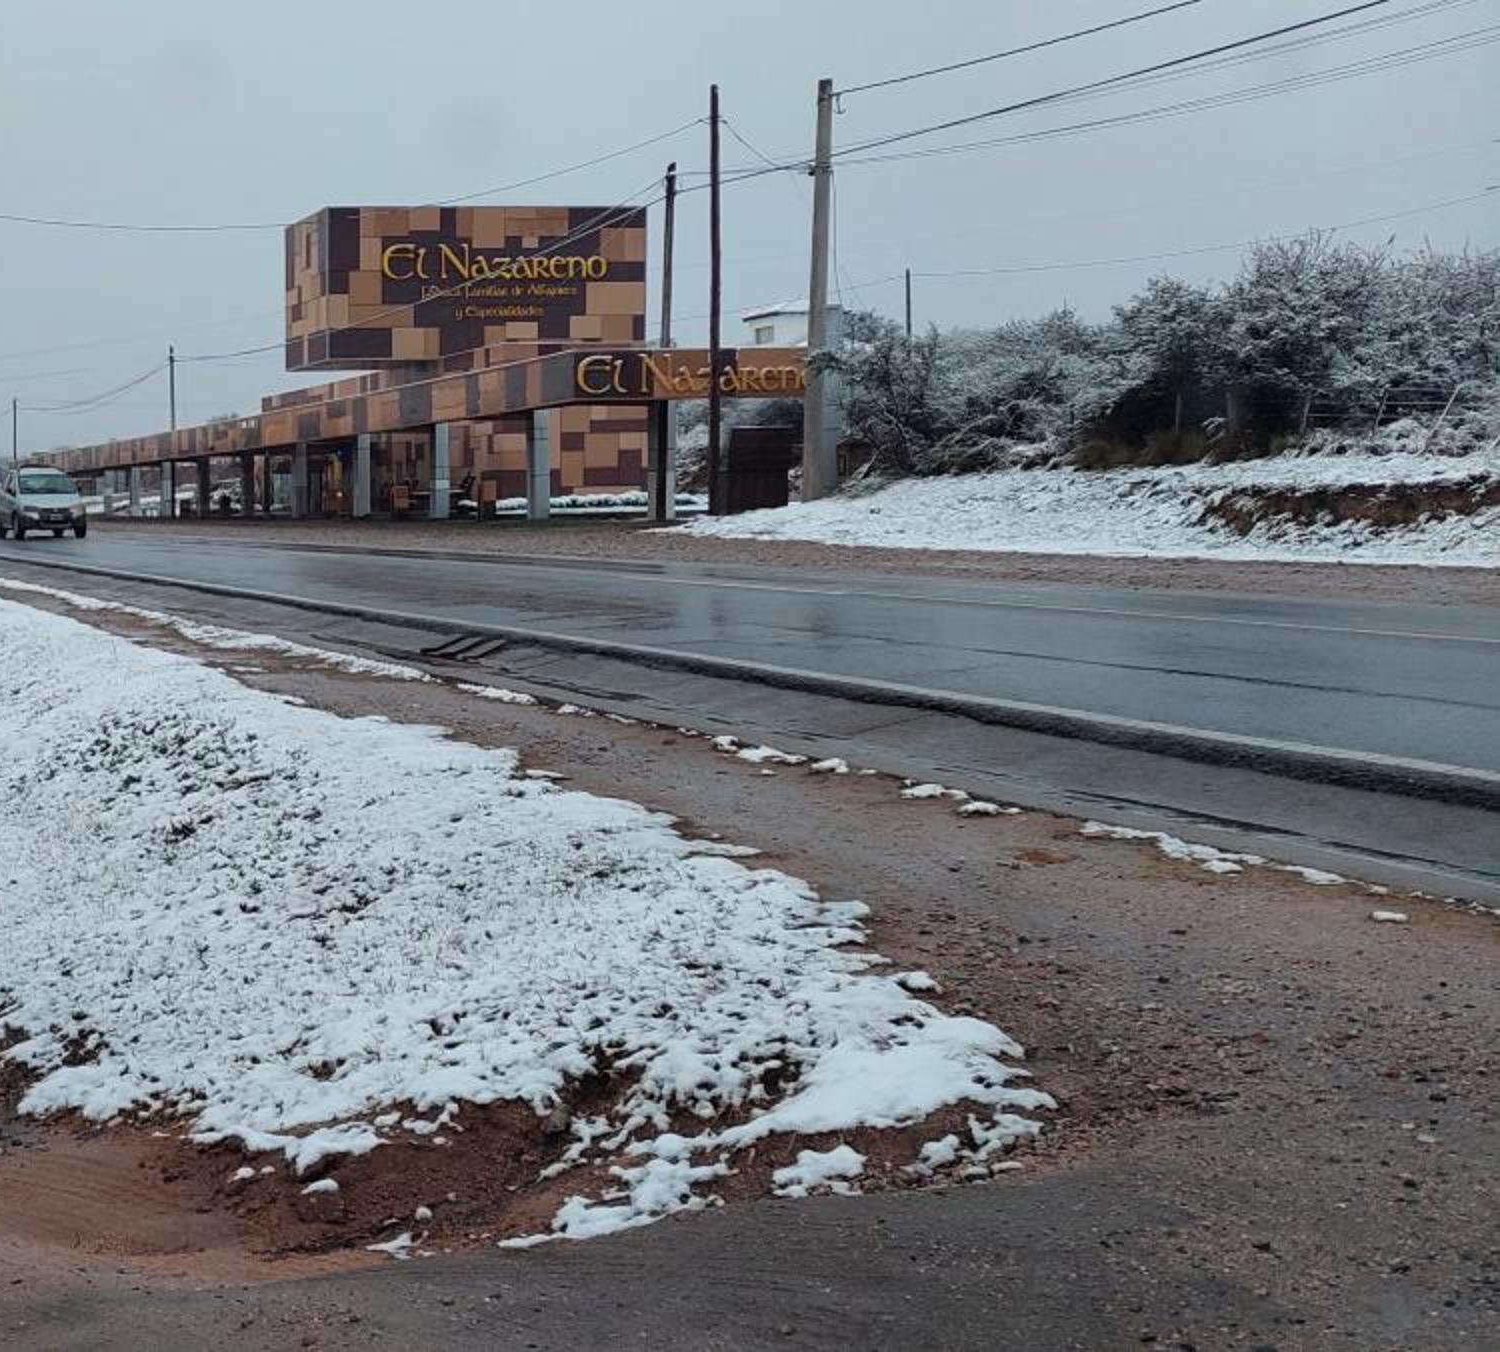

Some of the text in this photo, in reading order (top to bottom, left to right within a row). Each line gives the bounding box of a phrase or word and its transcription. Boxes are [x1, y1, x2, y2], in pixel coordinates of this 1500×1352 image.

[383, 243, 429, 279] El
[512, 285, 523, 296] de
[455, 308, 463, 320] y
[578, 353, 806, 393] El Nazaren
